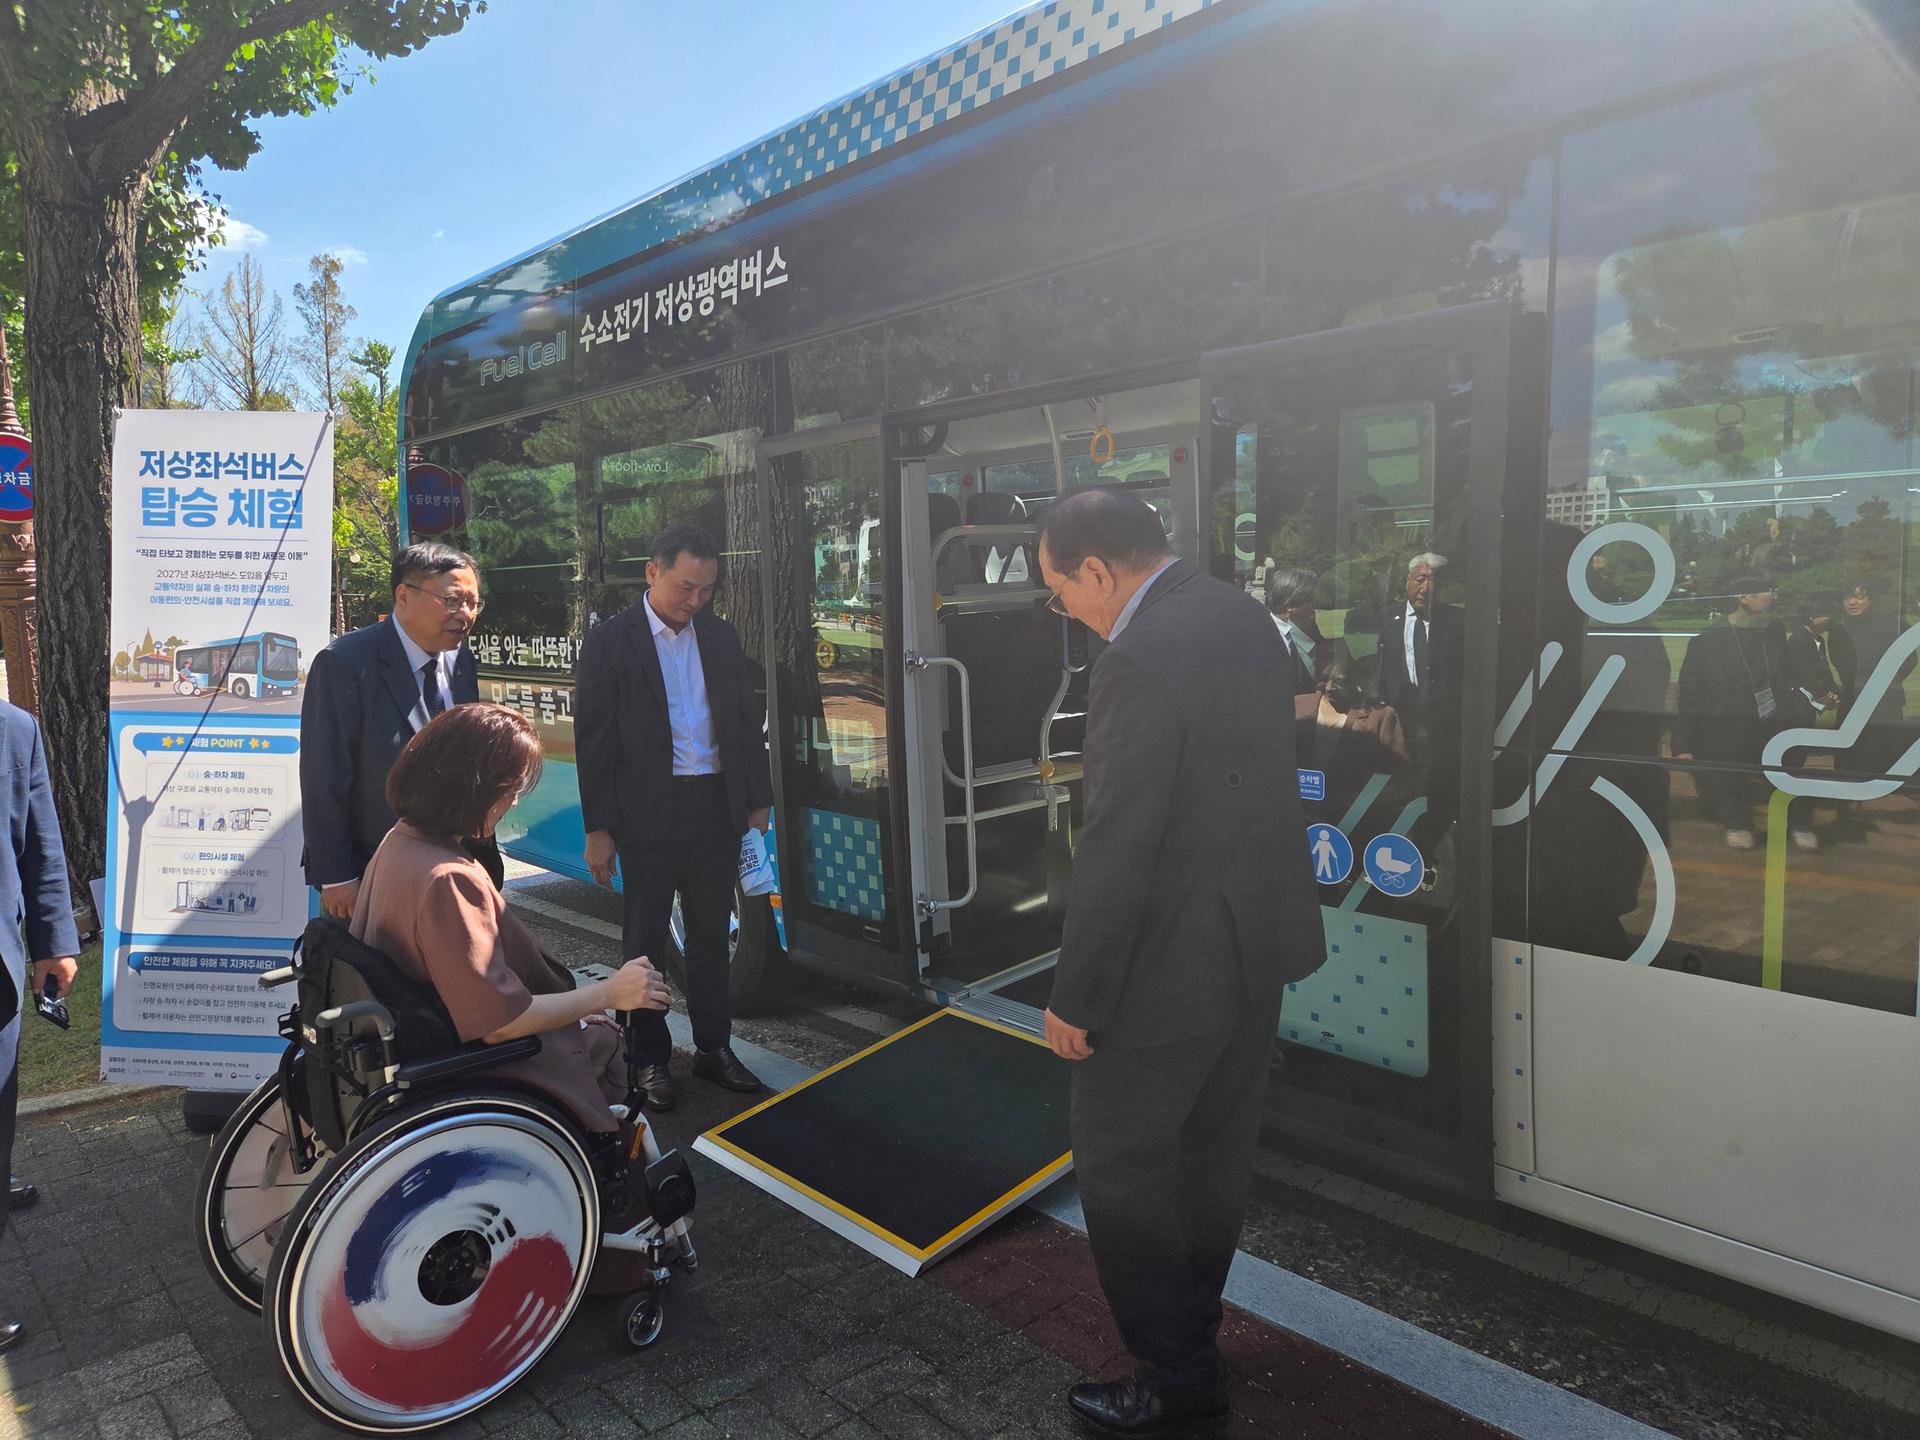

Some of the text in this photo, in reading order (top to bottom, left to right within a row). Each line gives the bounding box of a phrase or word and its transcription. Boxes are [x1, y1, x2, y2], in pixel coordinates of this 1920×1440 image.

[579, 246, 789, 352] 수소전기 저상광역버스
[480, 330, 567, 386] Fuel Cell
[139, 450, 305, 481] 저상좌석버스
[0, 471, 32, 486] 차금
[141, 486, 303, 529] 탑승 체험
[159, 549, 183, 559] 타보고
[185, 550, 217, 560] 경험하는
[219, 550, 242, 560] 모두를
[244, 551, 261, 560] 위한
[262, 551, 286, 561] 새로운
[156, 569, 189, 579] 2027년
[190, 569, 238, 579] 저상좌석버스
[239, 570, 263, 580] 도입을
[468, 633, 501, 666] 도심을
[504, 634, 529, 666] 잇는
[531, 635, 572, 669] 따뜻한
[539, 686, 575, 726] 품고
[191, 737, 245, 749] 체험 POINT
[230, 771, 245, 780] 체험
[230, 852, 245, 862] 체험
[143, 955, 276, 970] 안전한 체험을 위해 꼭 지켜주세요!
